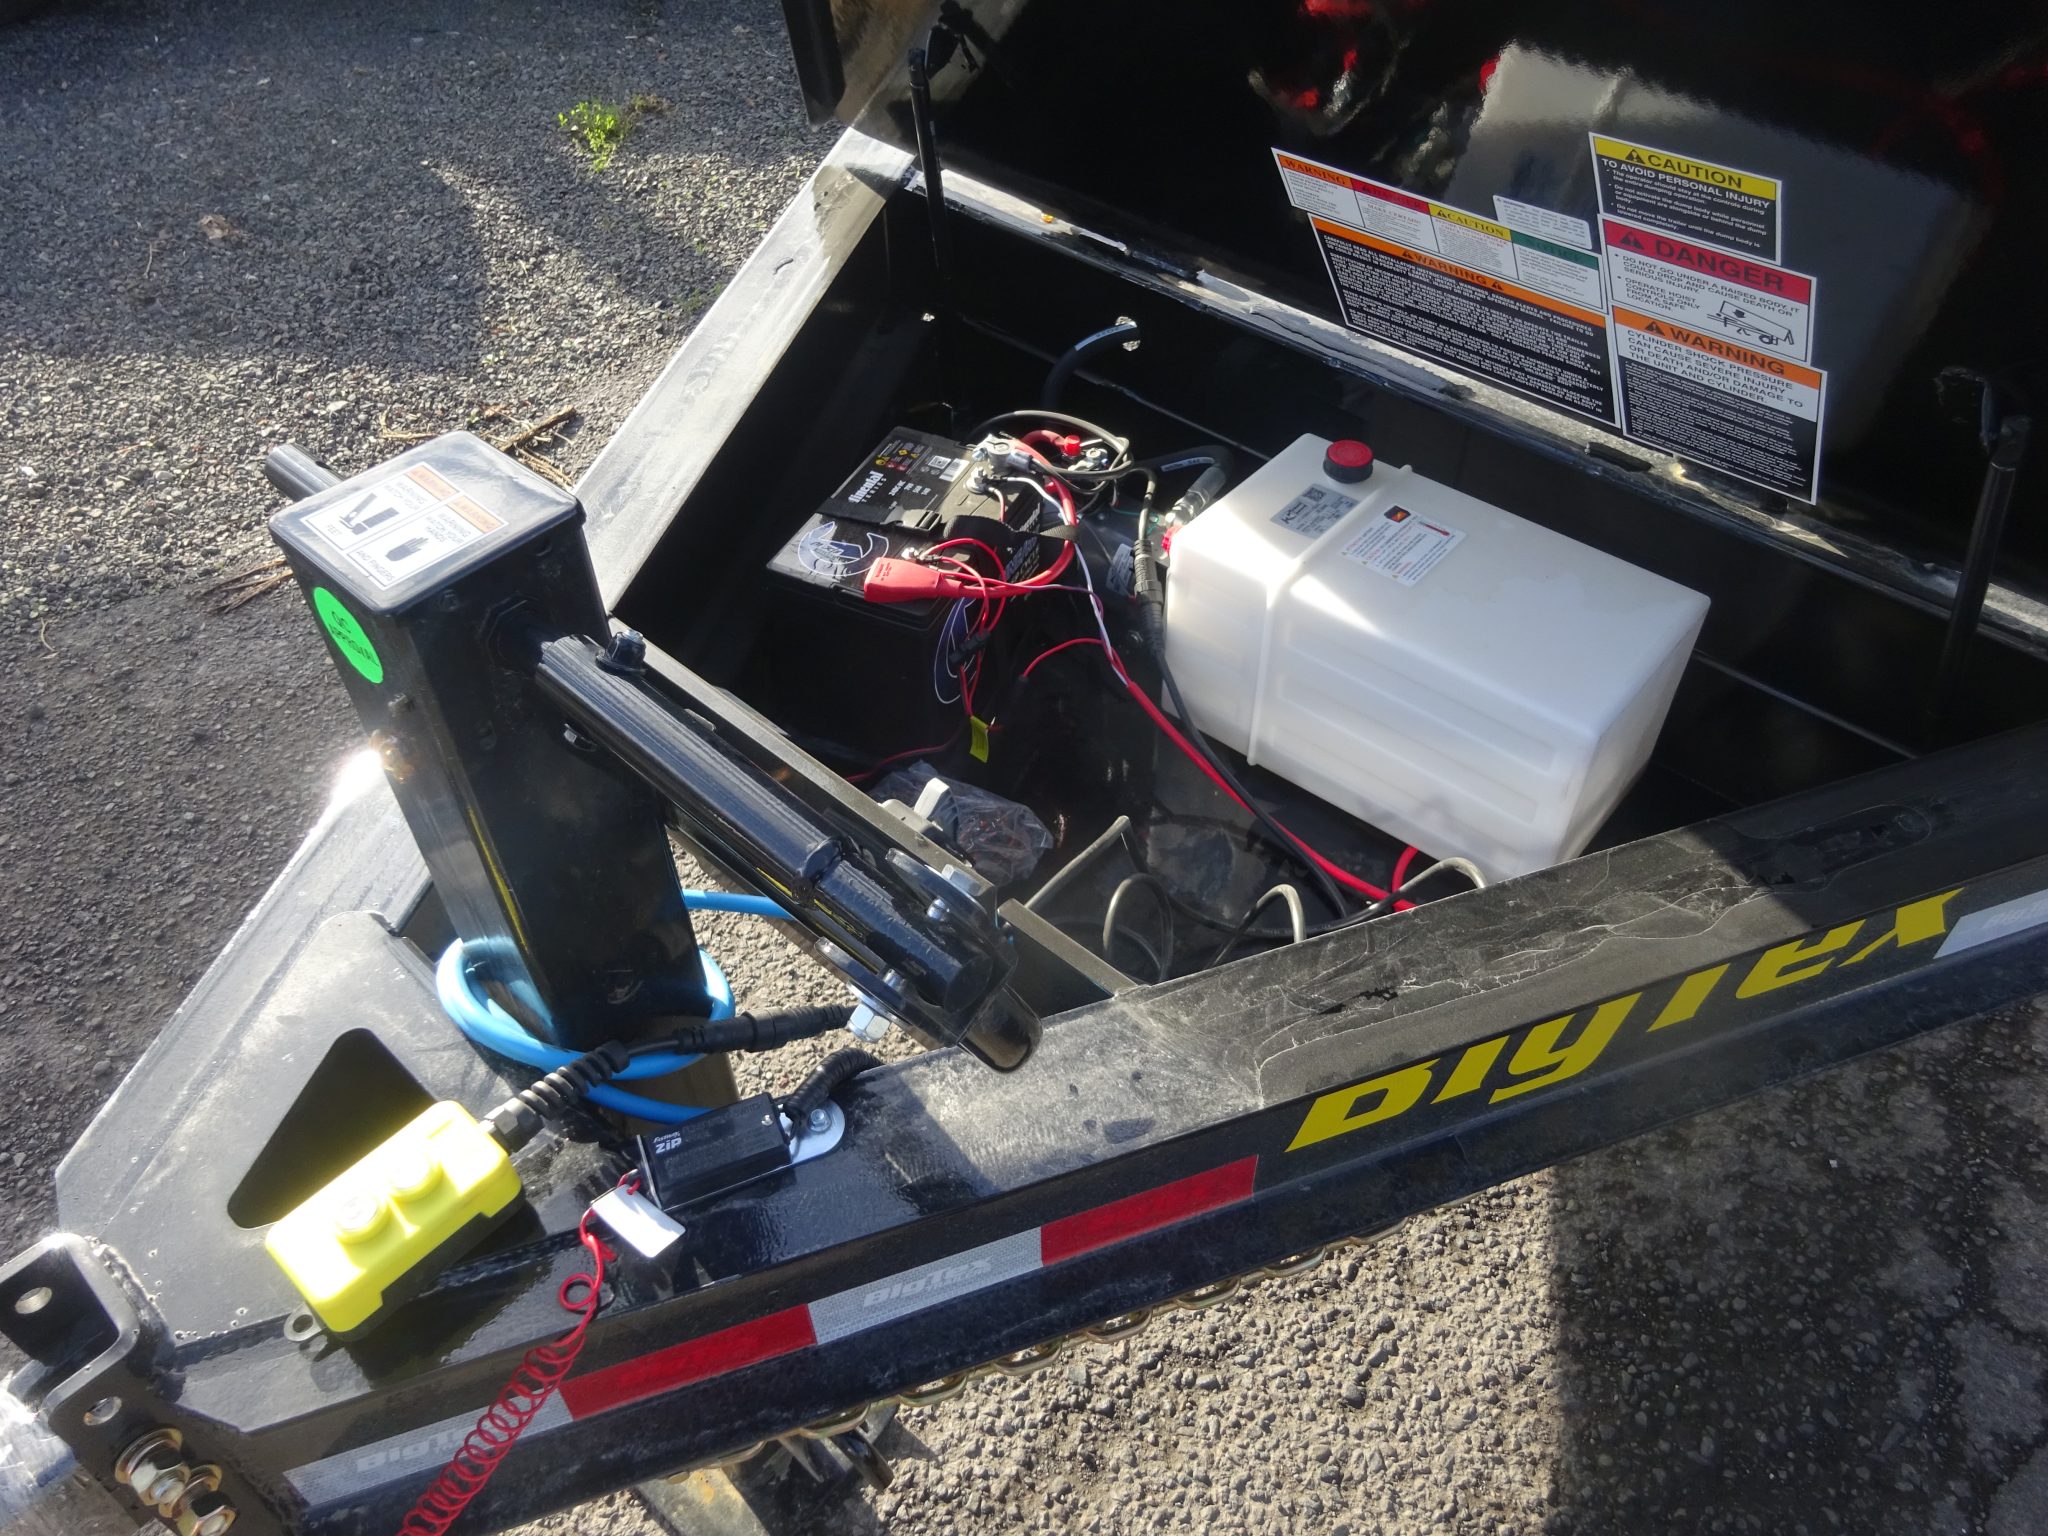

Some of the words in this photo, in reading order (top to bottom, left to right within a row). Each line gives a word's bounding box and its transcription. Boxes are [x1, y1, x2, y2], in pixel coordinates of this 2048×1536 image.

[1284, 158, 1346, 185] WARNING
[1601, 158, 1617, 169] TO
[1620, 163, 1655, 179] AVOID
[1658, 173, 1721, 196] PERSONAL
[1725, 190, 1769, 209] INJURY
[1647, 153, 1741, 189] CAUTION
[1446, 211, 1505, 237] CAUTION
[1415, 253, 1487, 285] WARNING
[1623, 266, 1663, 283] SERIOUS
[1655, 238, 1783, 292] DANGER
[1622, 255, 1636, 264] DO
[1638, 260, 1656, 270] NOT
[1660, 266, 1673, 275] GO
[1676, 271, 1708, 286] UNDER
[1721, 284, 1755, 300] RAISED
[1790, 305, 1799, 313] IT
[1623, 260, 1653, 275] COULD
[1657, 270, 1682, 283] DROP
[1685, 279, 1704, 290] AND
[1708, 286, 1738, 300] CAUSE
[1743, 296, 1774, 311] DEATH
[1777, 306, 1792, 316] OR
[1625, 277, 1665, 294] OPERATE
[1668, 290, 1695, 303] HOIST
[1625, 282, 1673, 301] CONTROLS
[1676, 298, 1700, 309] ONLY
[1626, 288, 1651, 300] FROM
[1663, 299, 1685, 310] SAFE
[1627, 329, 1682, 353] CYLINDER
[1685, 348, 1725, 367] SHOCK
[1729, 362, 1792, 389] PRESSURE
[1628, 336, 1650, 350] CAN
[1654, 345, 1692, 364] CAUSE
[1695, 358, 1740, 380] SEVERE
[1743, 374, 1785, 394] INJURY
[1629, 351, 1650, 364] THE
[1653, 359, 1677, 373] UNIT
[1681, 368, 1703, 382] AND
[1670, 327, 1784, 375] WARNING
[1628, 344, 1644, 355] OR
[1647, 350, 1683, 368] DEATH
[1686, 363, 1728, 383] AND/OR
[1733, 378, 1782, 401] DAMAGE
[1787, 396, 1802, 408] TO
[848, 470, 885, 504] tinental
